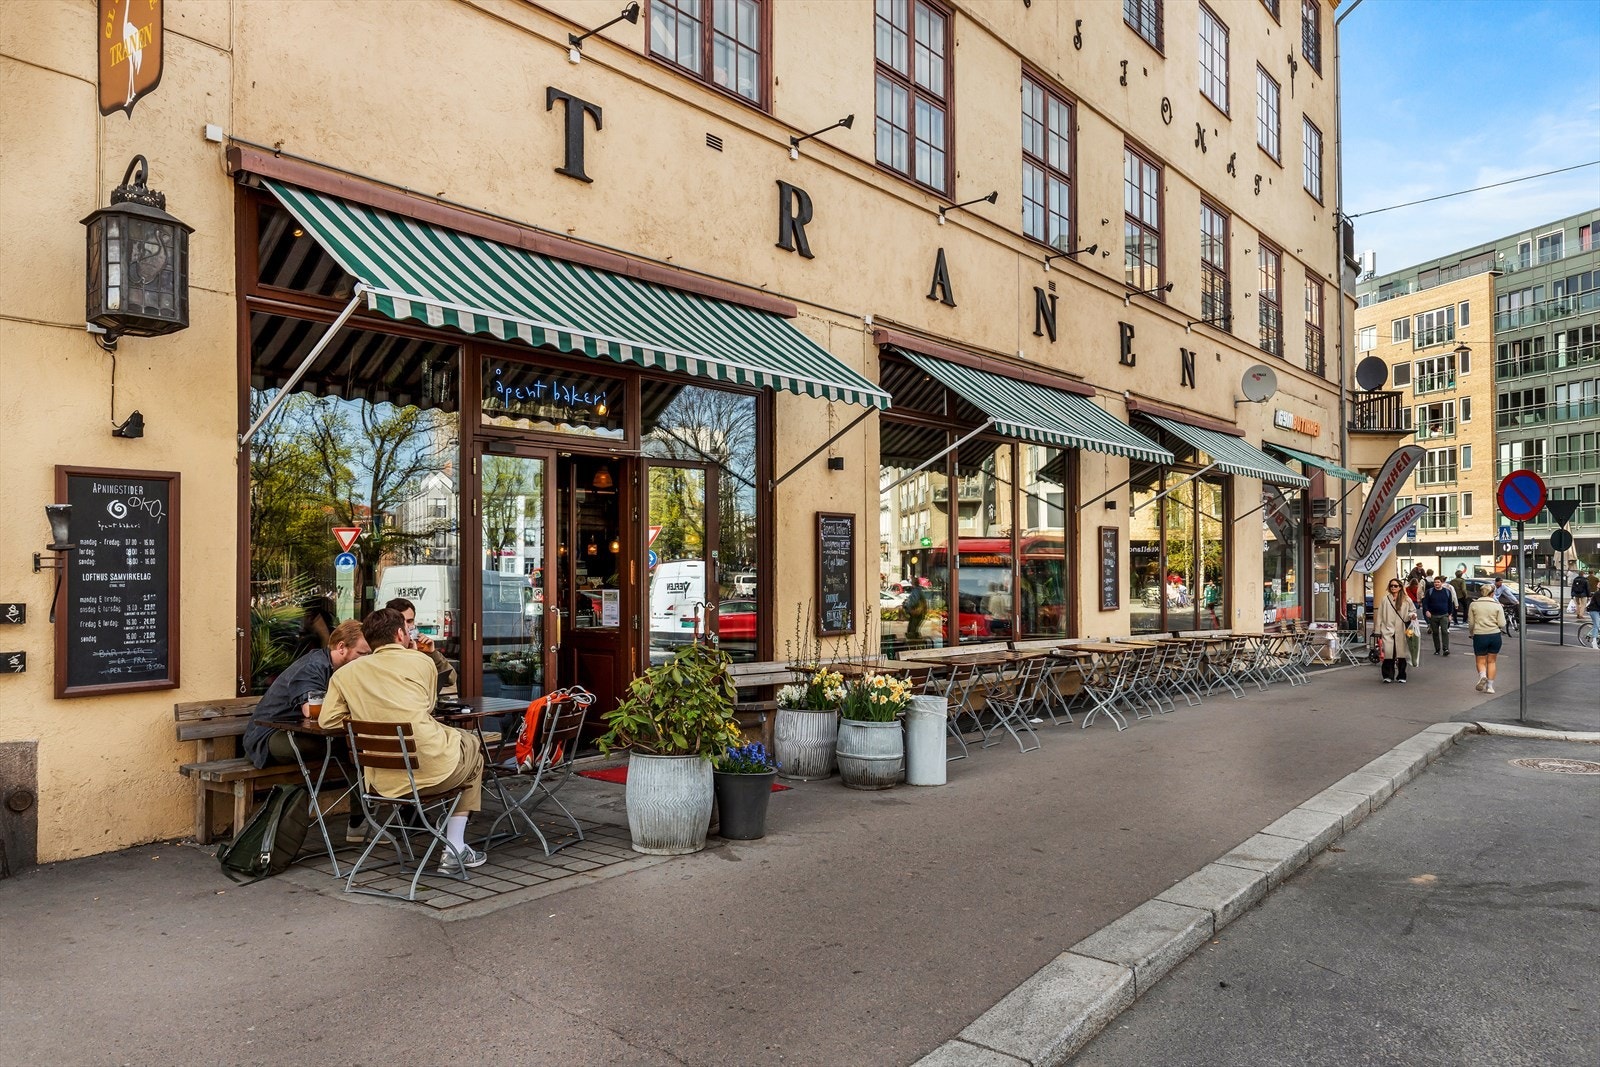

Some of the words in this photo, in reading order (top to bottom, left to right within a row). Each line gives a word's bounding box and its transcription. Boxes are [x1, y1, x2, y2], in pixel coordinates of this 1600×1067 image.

[109, 22, 153, 68] TRANEN
[1023, 0, 1263, 196] SIONAT
[546, 86, 1197, 390] TRANEN
[495, 368, 547, 409] åpent
[553, 381, 606, 406] bakeri
[82, 573, 108, 582] LOFTHUS
[109, 572, 152, 581] SAMVIRKELAG
